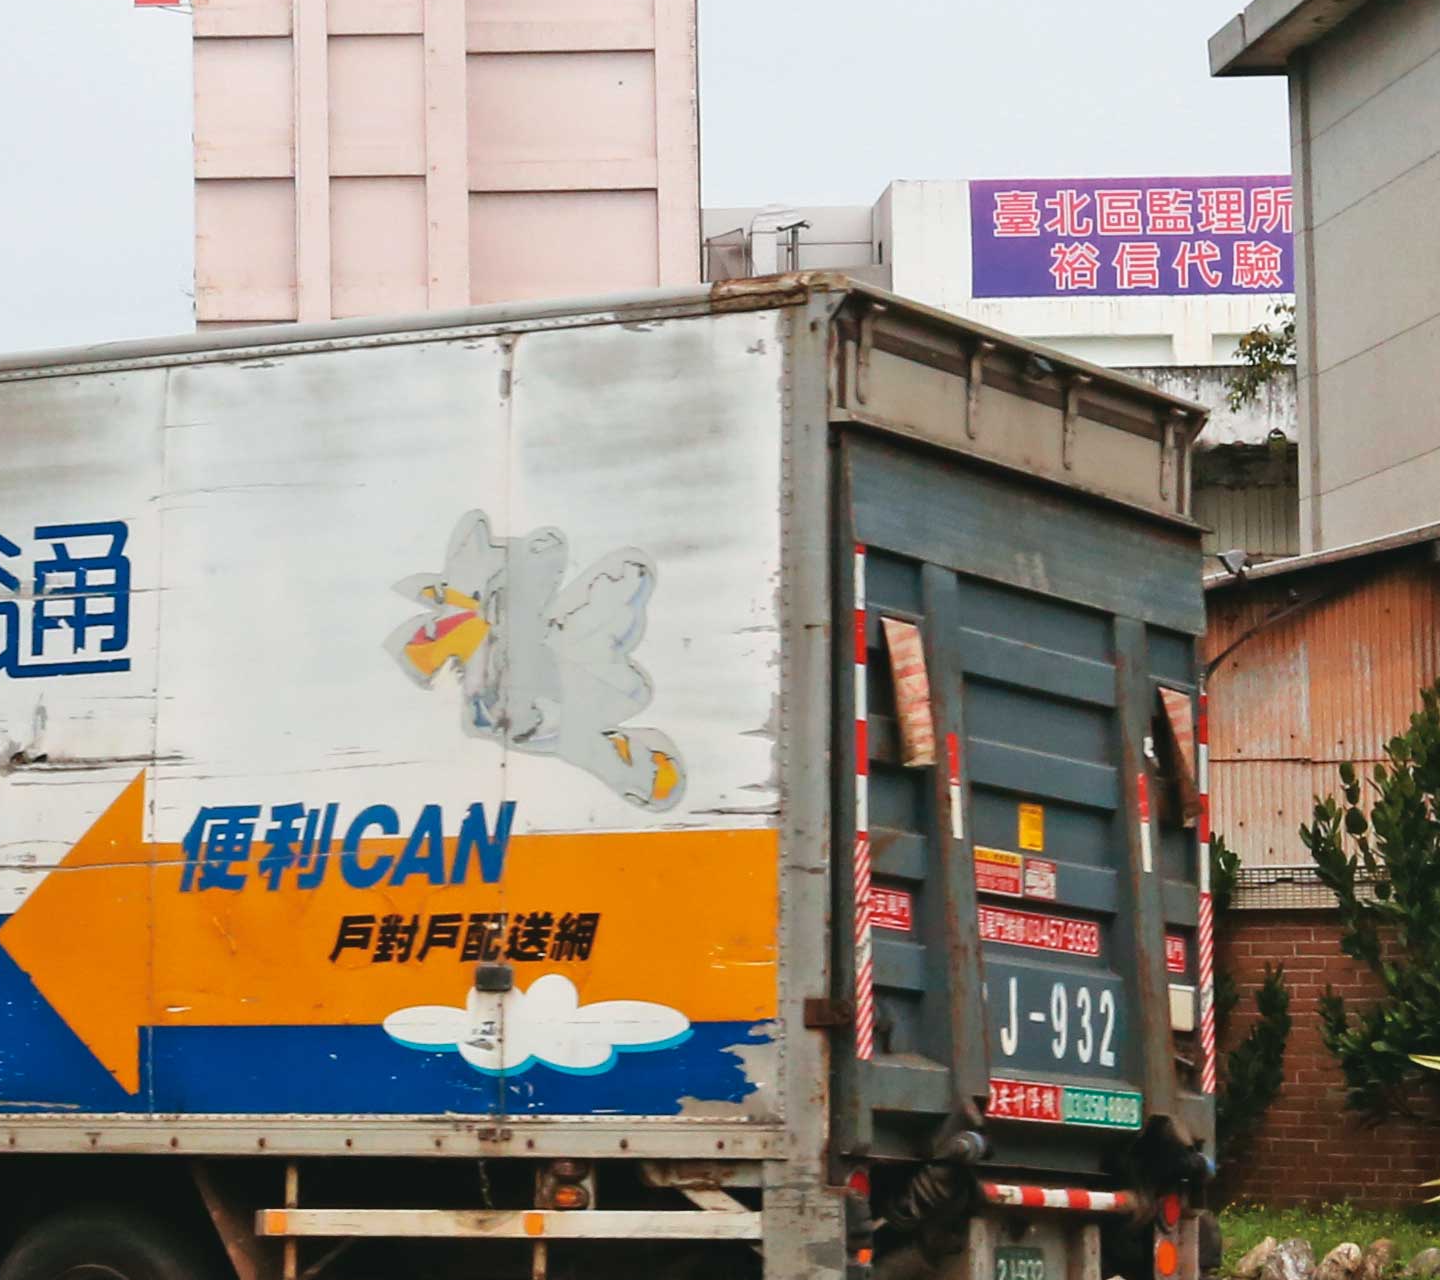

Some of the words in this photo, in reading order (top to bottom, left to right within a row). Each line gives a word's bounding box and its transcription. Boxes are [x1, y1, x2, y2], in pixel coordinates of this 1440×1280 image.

[993, 186, 1293, 238] 臺北區監理所
[1050, 240, 1284, 290] 裕信代驗
[179, 801, 516, 894] 便利CAN
[329, 912, 600, 964] 戶對戶配送網
[982, 976, 1115, 1067] J-932
